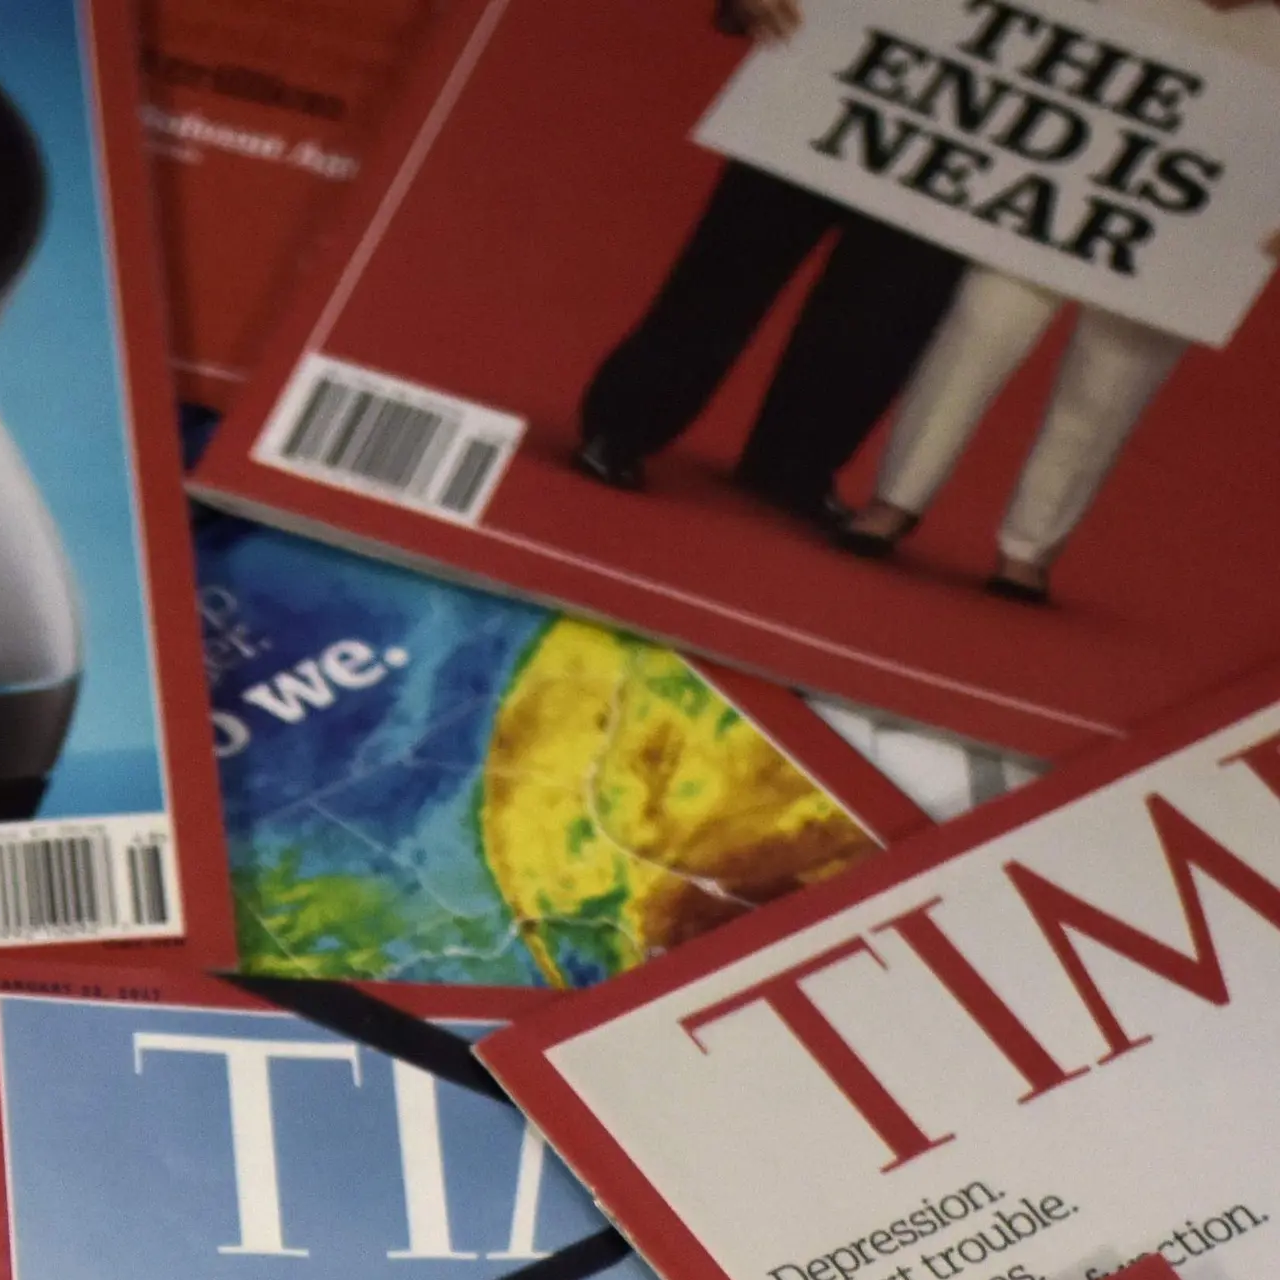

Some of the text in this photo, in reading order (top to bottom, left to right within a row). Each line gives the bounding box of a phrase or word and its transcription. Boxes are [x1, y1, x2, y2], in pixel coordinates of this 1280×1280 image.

[834, 26, 1226, 216] END IS
[958, 0, 1204, 133] THE
[810, 99, 1156, 277] NEAR
[241, 637, 409, 724] we.
[677, 732, 1280, 1173] TIM
